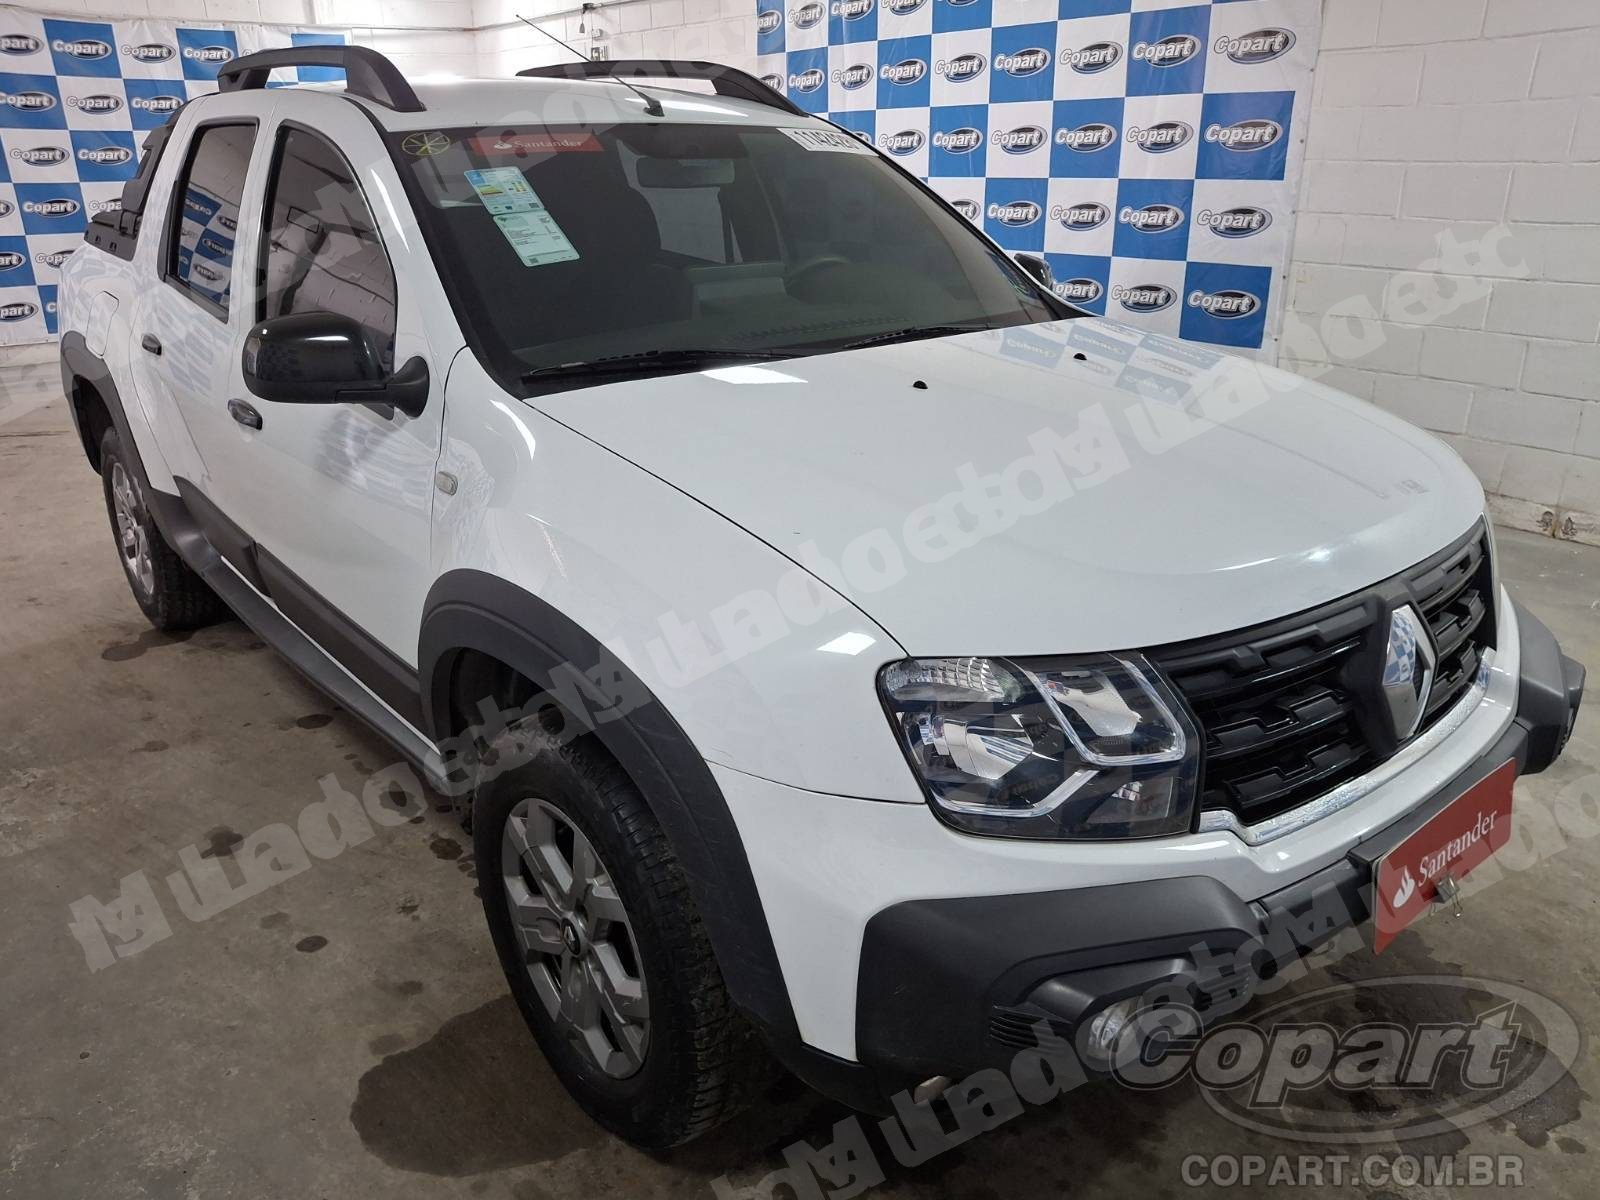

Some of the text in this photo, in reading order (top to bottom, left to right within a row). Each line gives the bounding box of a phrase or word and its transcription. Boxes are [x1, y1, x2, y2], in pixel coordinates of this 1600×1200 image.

[789, 5, 820, 24] Copart
[831, 0, 868, 15] Copart
[758, 13, 777, 29] part
[0, 37, 35, 50] part
[53, 39, 106, 55] Copart
[121, 45, 169, 59] Copart
[1132, 35, 1195, 61] Copart
[1214, 32, 1286, 56] Copart
[183, 47, 229, 60] Copart
[993, 51, 1044, 73] Copart
[1059, 45, 1116, 66] Copart
[880, 61, 921, 80] Copart
[934, 57, 981, 78] Copart
[788, 71, 821, 89] Copart
[831, 67, 871, 88] Copart
[66, 95, 116, 110] Copart
[131, 97, 178, 111] Copart
[878, 133, 919, 150] Copart
[933, 130, 977, 149] Copart
[991, 128, 1040, 149] Copart
[1056, 125, 1111, 147] Copart
[1127, 124, 1184, 147] Copart
[1205, 122, 1278, 144] Copart
[513, 138, 584, 149] Santander
[10, 147, 62, 162] Copart
[78, 148, 127, 162] Copart
[23, 201, 75, 215] Copart
[89, 200, 122, 212] Copa
[987, 202, 1036, 222] Copart
[1050, 200, 1103, 224] Copart
[1119, 206, 1176, 229] Copart
[1197, 209, 1263, 232] Copart
[1111, 282, 1168, 306] Copart
[1188, 290, 1253, 314] Copart
[0, 304, 31, 319] part
[1417, 806, 1498, 887] Santander
